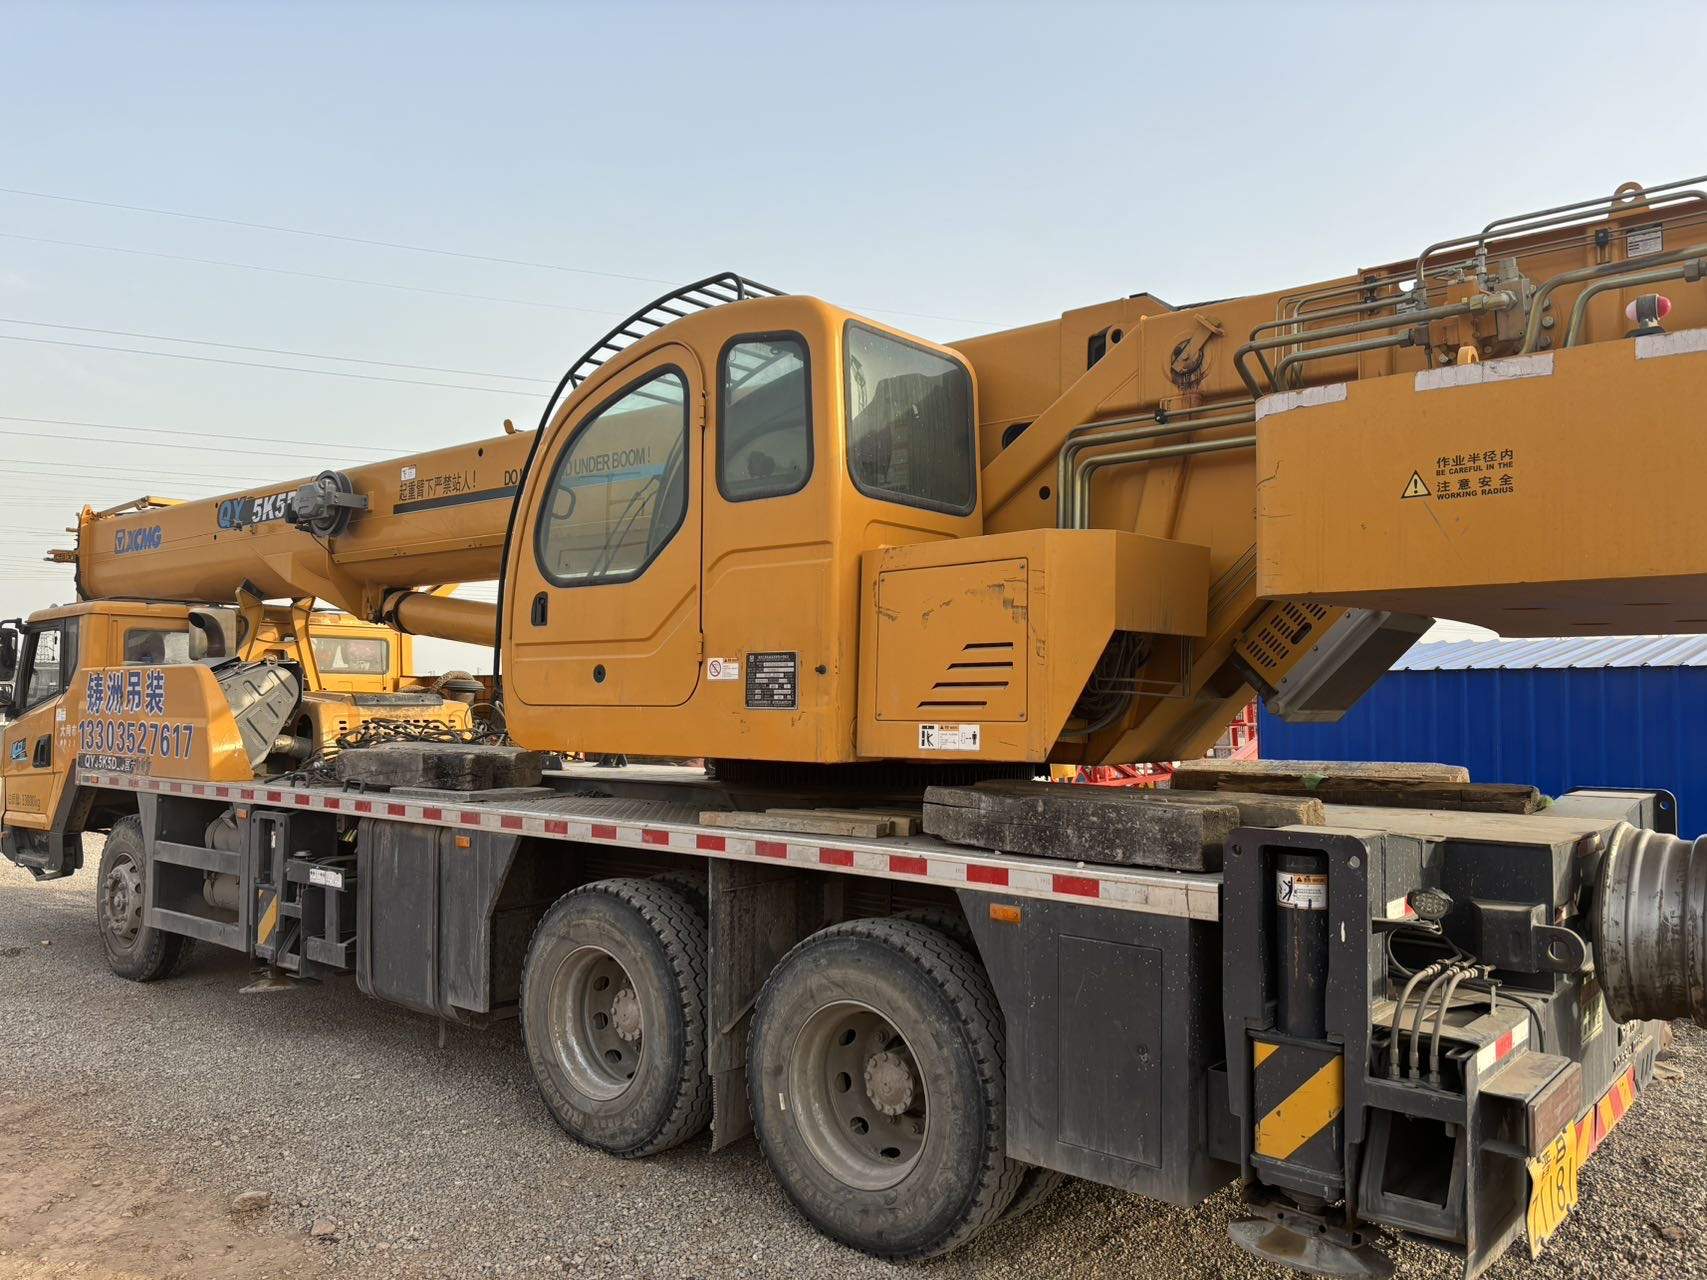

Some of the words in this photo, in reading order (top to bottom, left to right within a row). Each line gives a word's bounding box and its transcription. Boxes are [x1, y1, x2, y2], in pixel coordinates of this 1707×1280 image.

[575, 454, 611, 475] UNDER
[1436, 449, 1514, 468] 作业半径内
[1449, 465, 1483, 475] CAREFUL
[1486, 463, 1495, 471] IN
[1498, 461, 1514, 469] THE
[504, 469, 518, 486] DO
[1436, 474, 1514, 493] 注意安全
[1437, 490, 1478, 500] WORKING
[1481, 486, 1514, 496] RADIUS
[126, 526, 162, 552] XCMG
[79, 719, 194, 760] 13303527617
